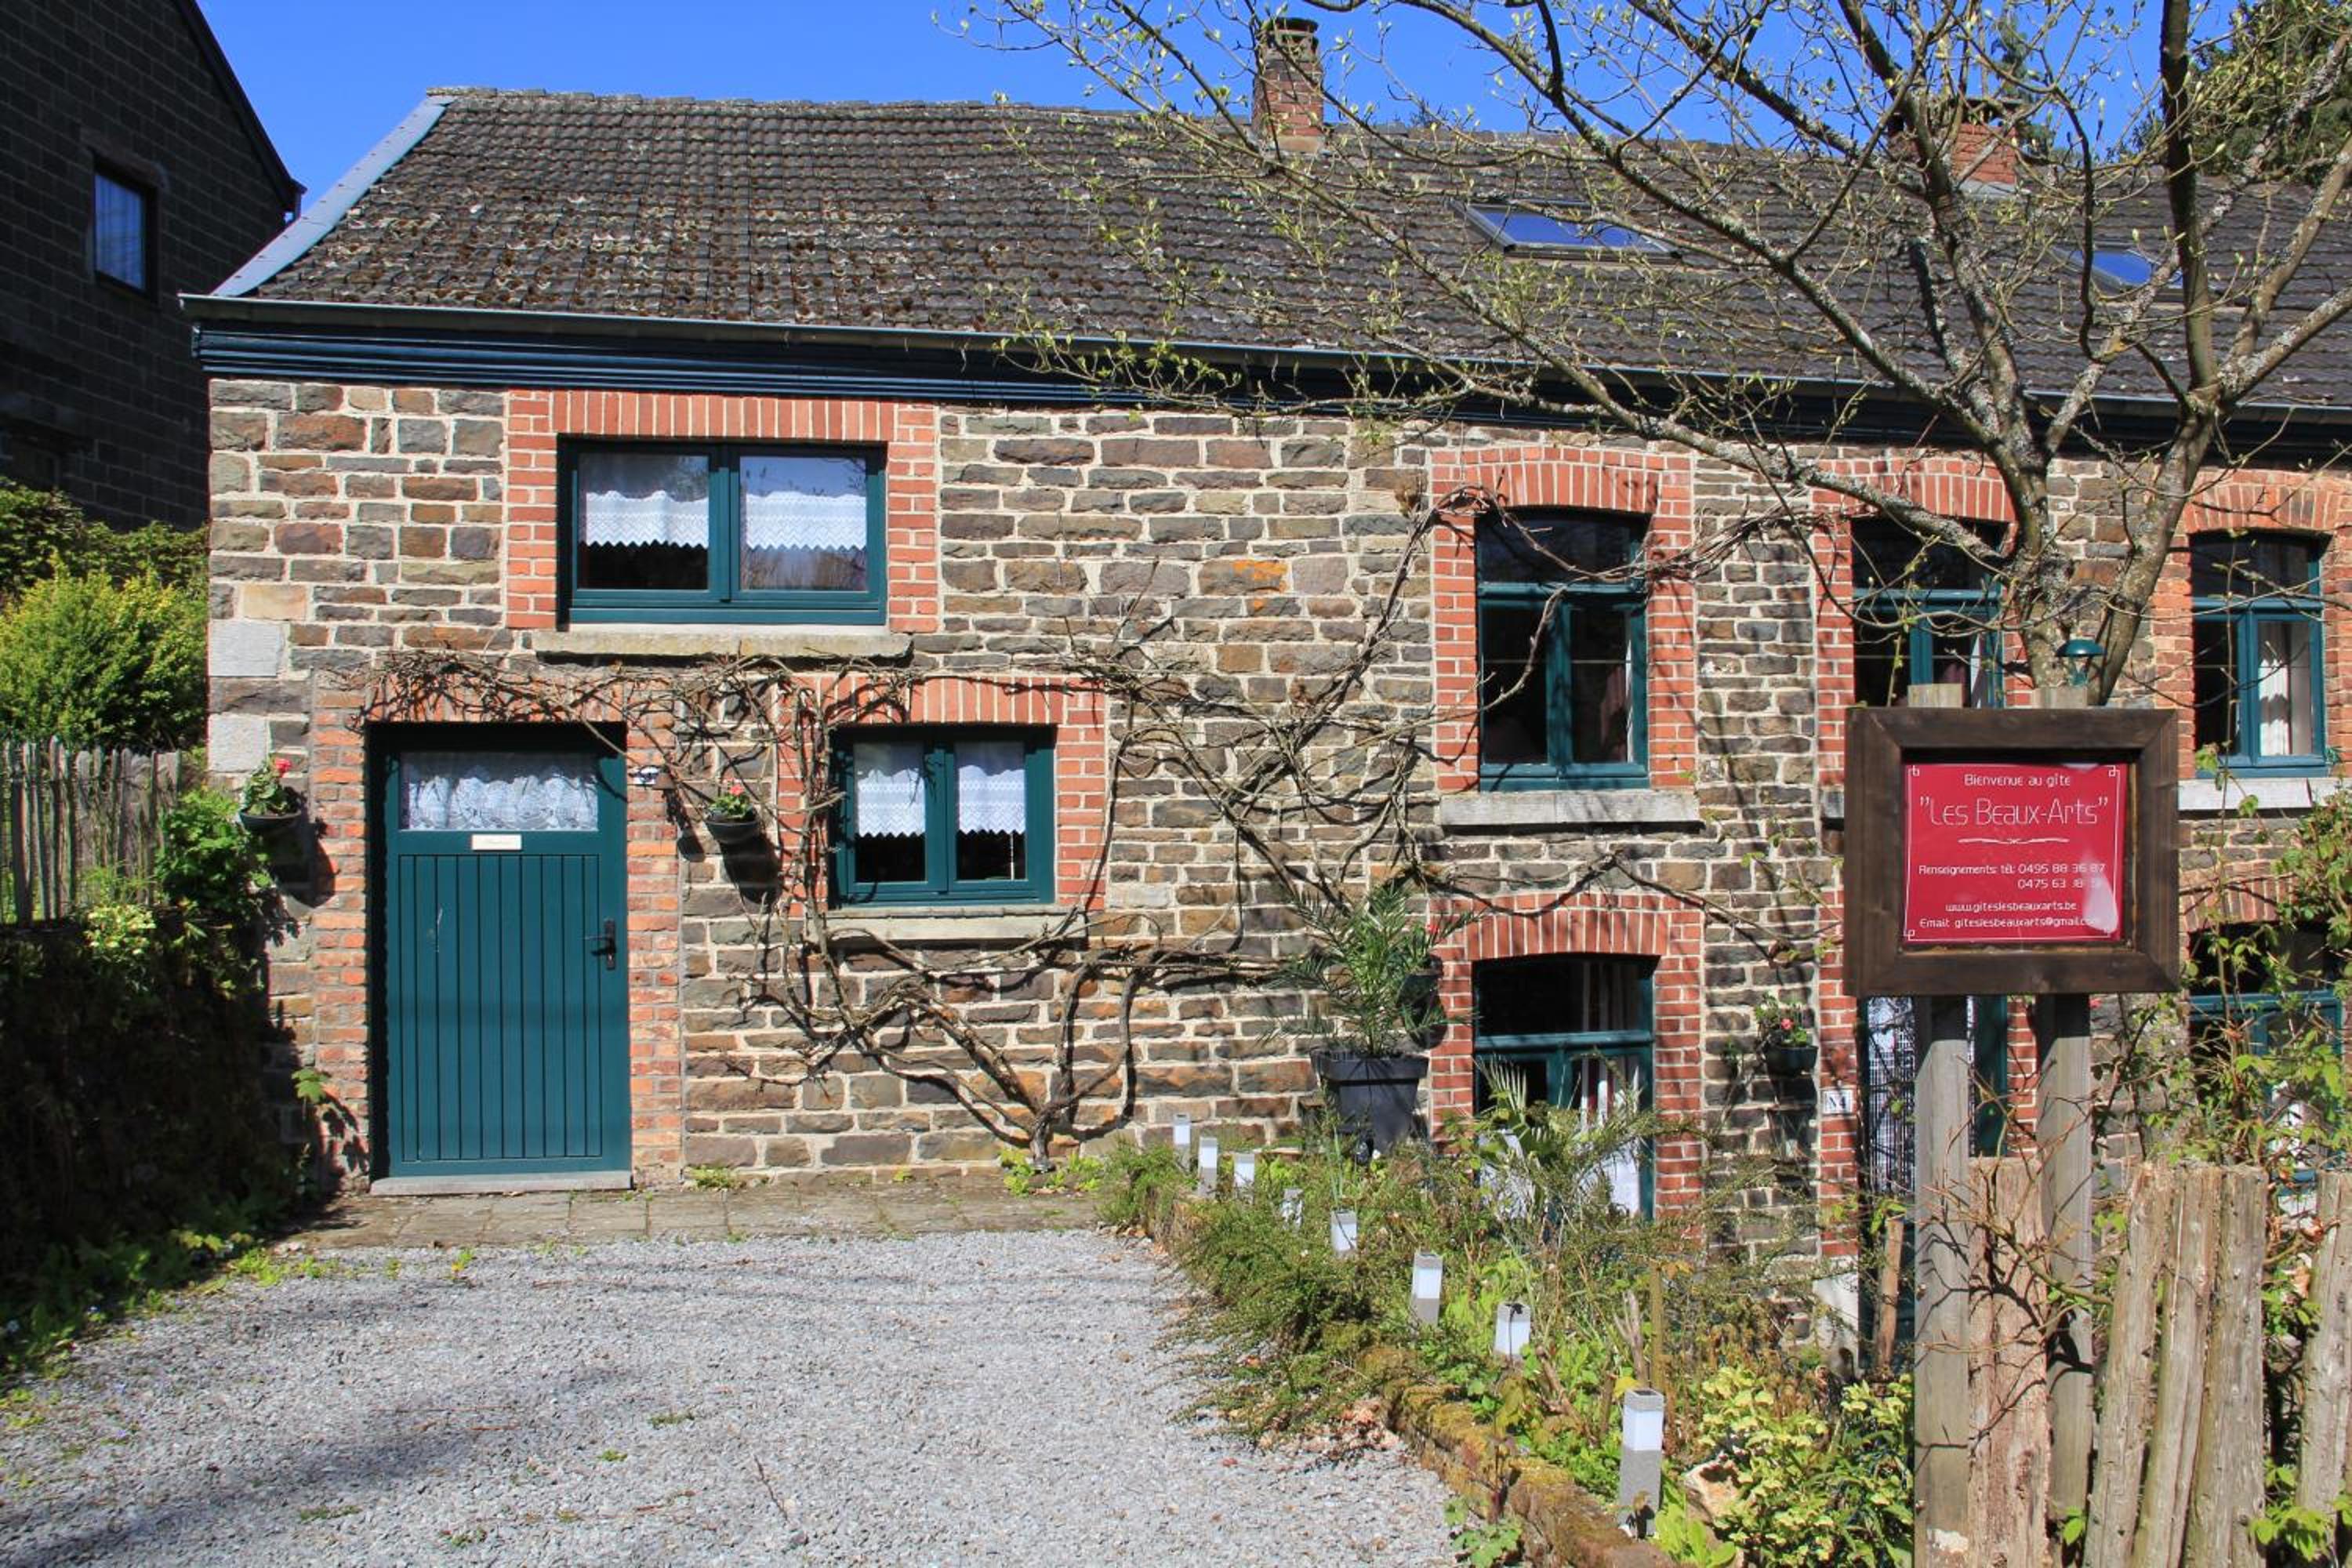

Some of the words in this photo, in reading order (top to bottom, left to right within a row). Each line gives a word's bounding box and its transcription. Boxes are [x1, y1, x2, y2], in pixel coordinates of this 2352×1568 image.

[1964, 773, 2023, 786] Bienvenue
[2027, 776, 2042, 786] au
[2017, 863, 2049, 874] 0495
[2052, 863, 2068, 874] 88
[2017, 878, 2049, 889] 0475
[2052, 878, 2067, 888] 63
